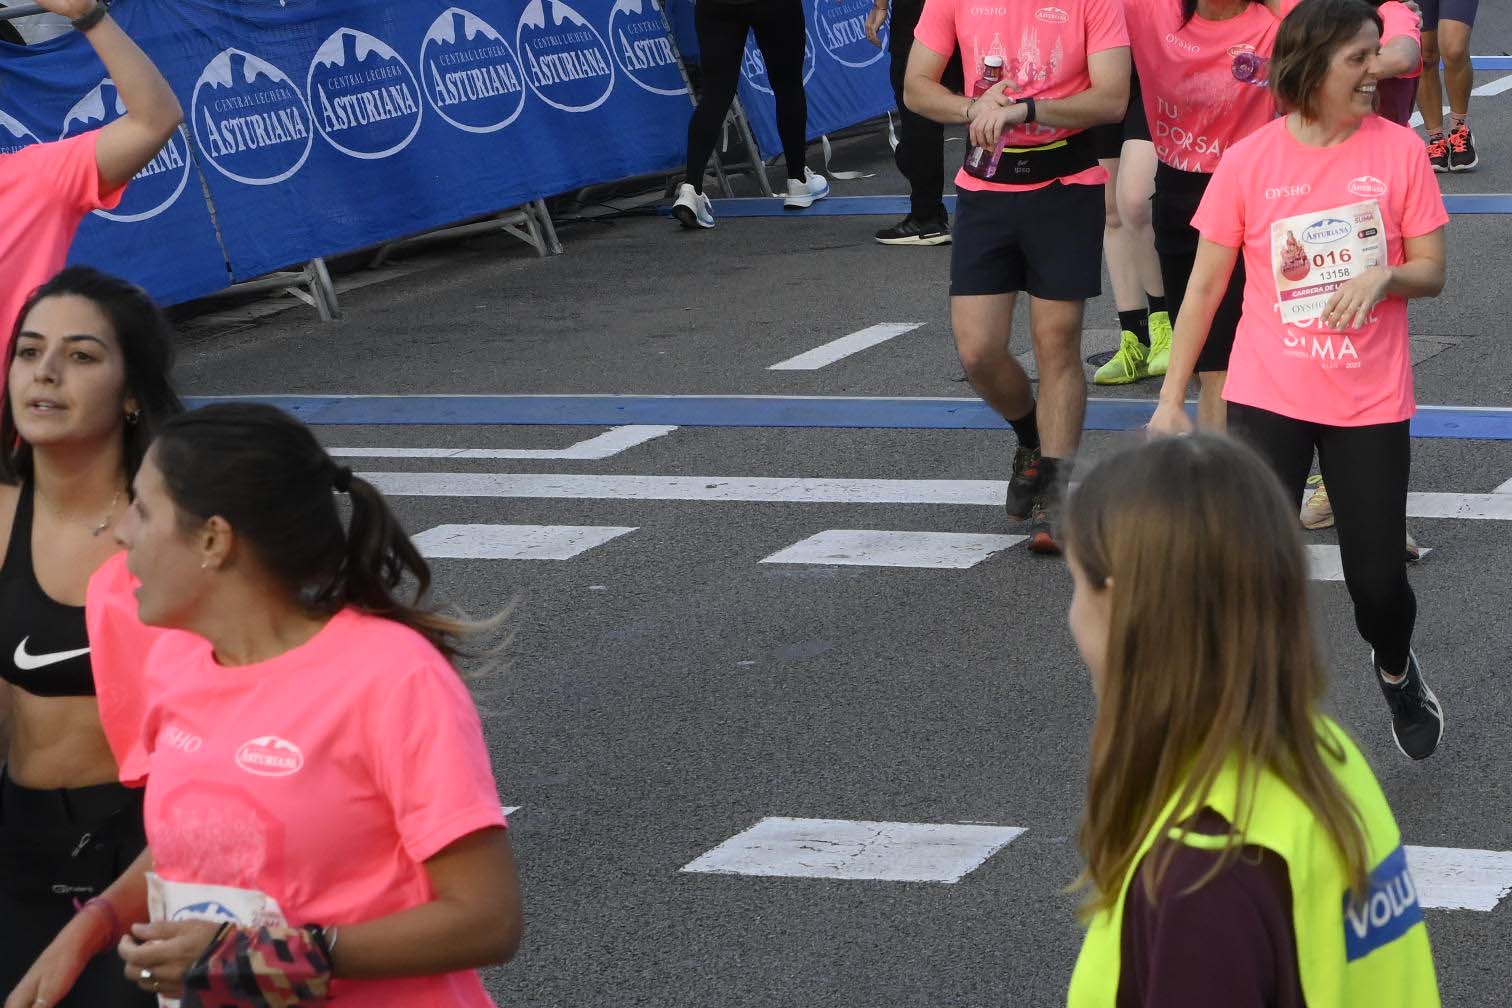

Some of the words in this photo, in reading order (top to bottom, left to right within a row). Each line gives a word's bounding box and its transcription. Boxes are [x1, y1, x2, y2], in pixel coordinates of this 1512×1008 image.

[525, 42, 610, 88] ASTURIANA
[430, 59, 521, 107] ASTURIANA
[318, 82, 418, 133] ASTURIANA
[1157, 96, 1178, 118] TU
[203, 105, 307, 159] ASTURIANA
[1265, 183, 1311, 200] OYSHO
[1306, 226, 1349, 241] ASTURIANA
[1312, 248, 1352, 267] 016
[1320, 267, 1350, 281] 13158
[1325, 284, 1334, 292] DE
